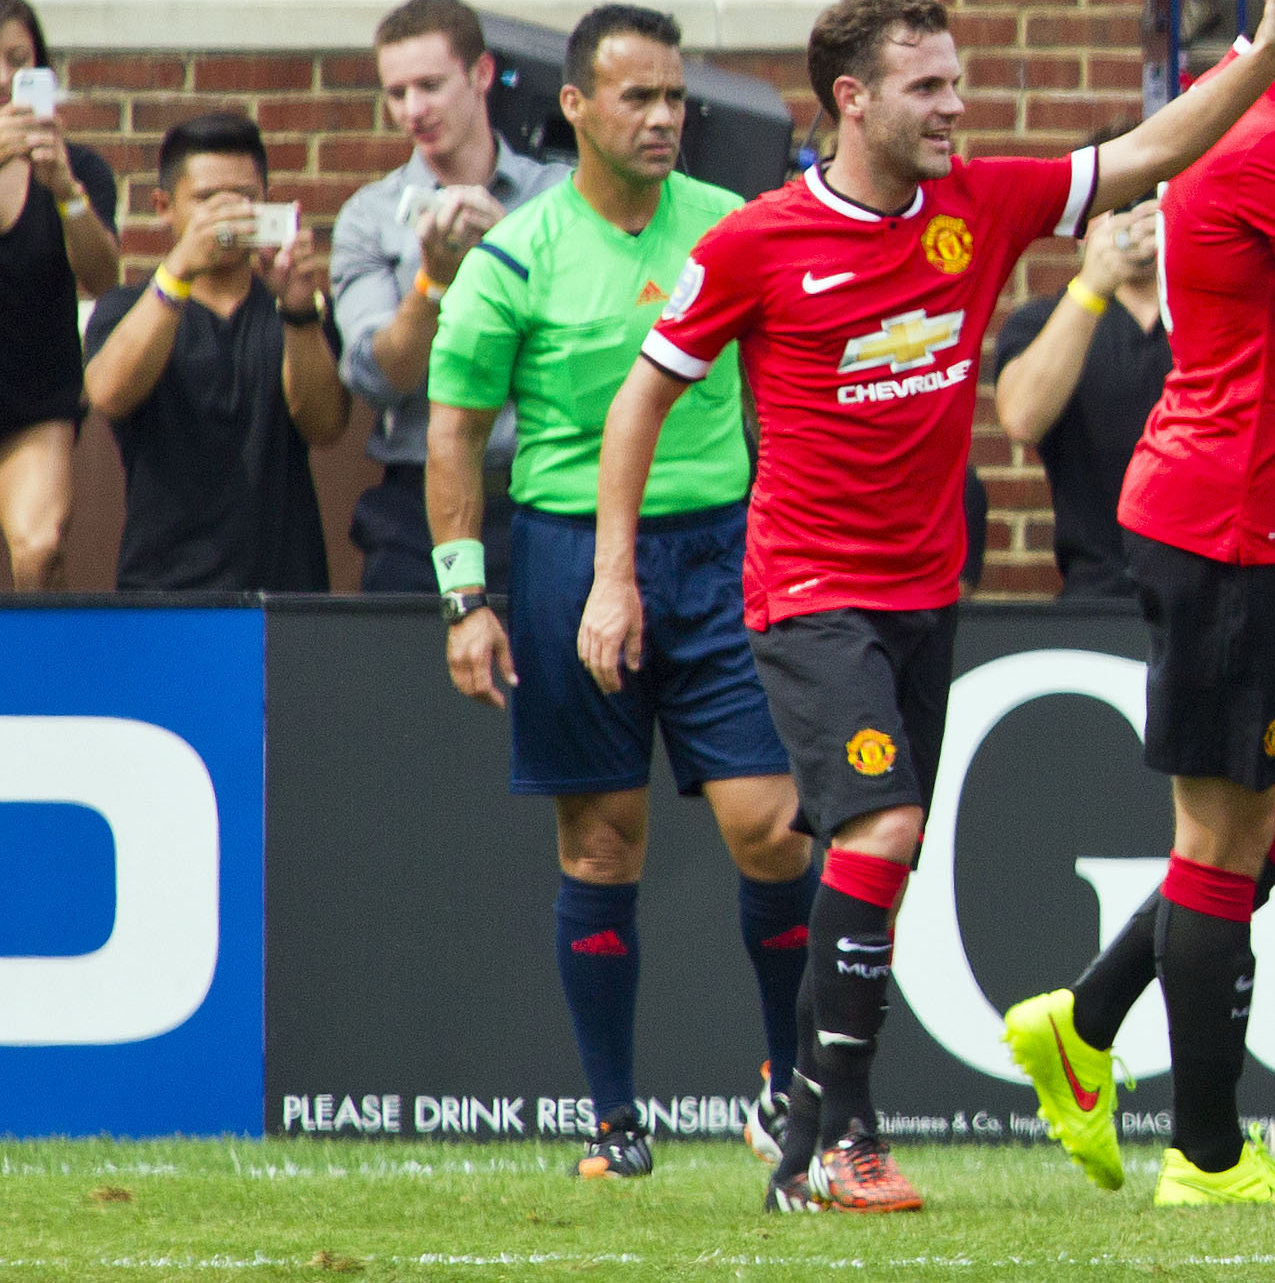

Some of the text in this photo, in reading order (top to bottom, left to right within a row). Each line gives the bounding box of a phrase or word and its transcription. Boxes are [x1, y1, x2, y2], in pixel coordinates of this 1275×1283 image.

[836, 359, 974, 405] CHEVROLE
[283, 1093, 760, 1135] PLEASE DRINK RESONSIBLY
